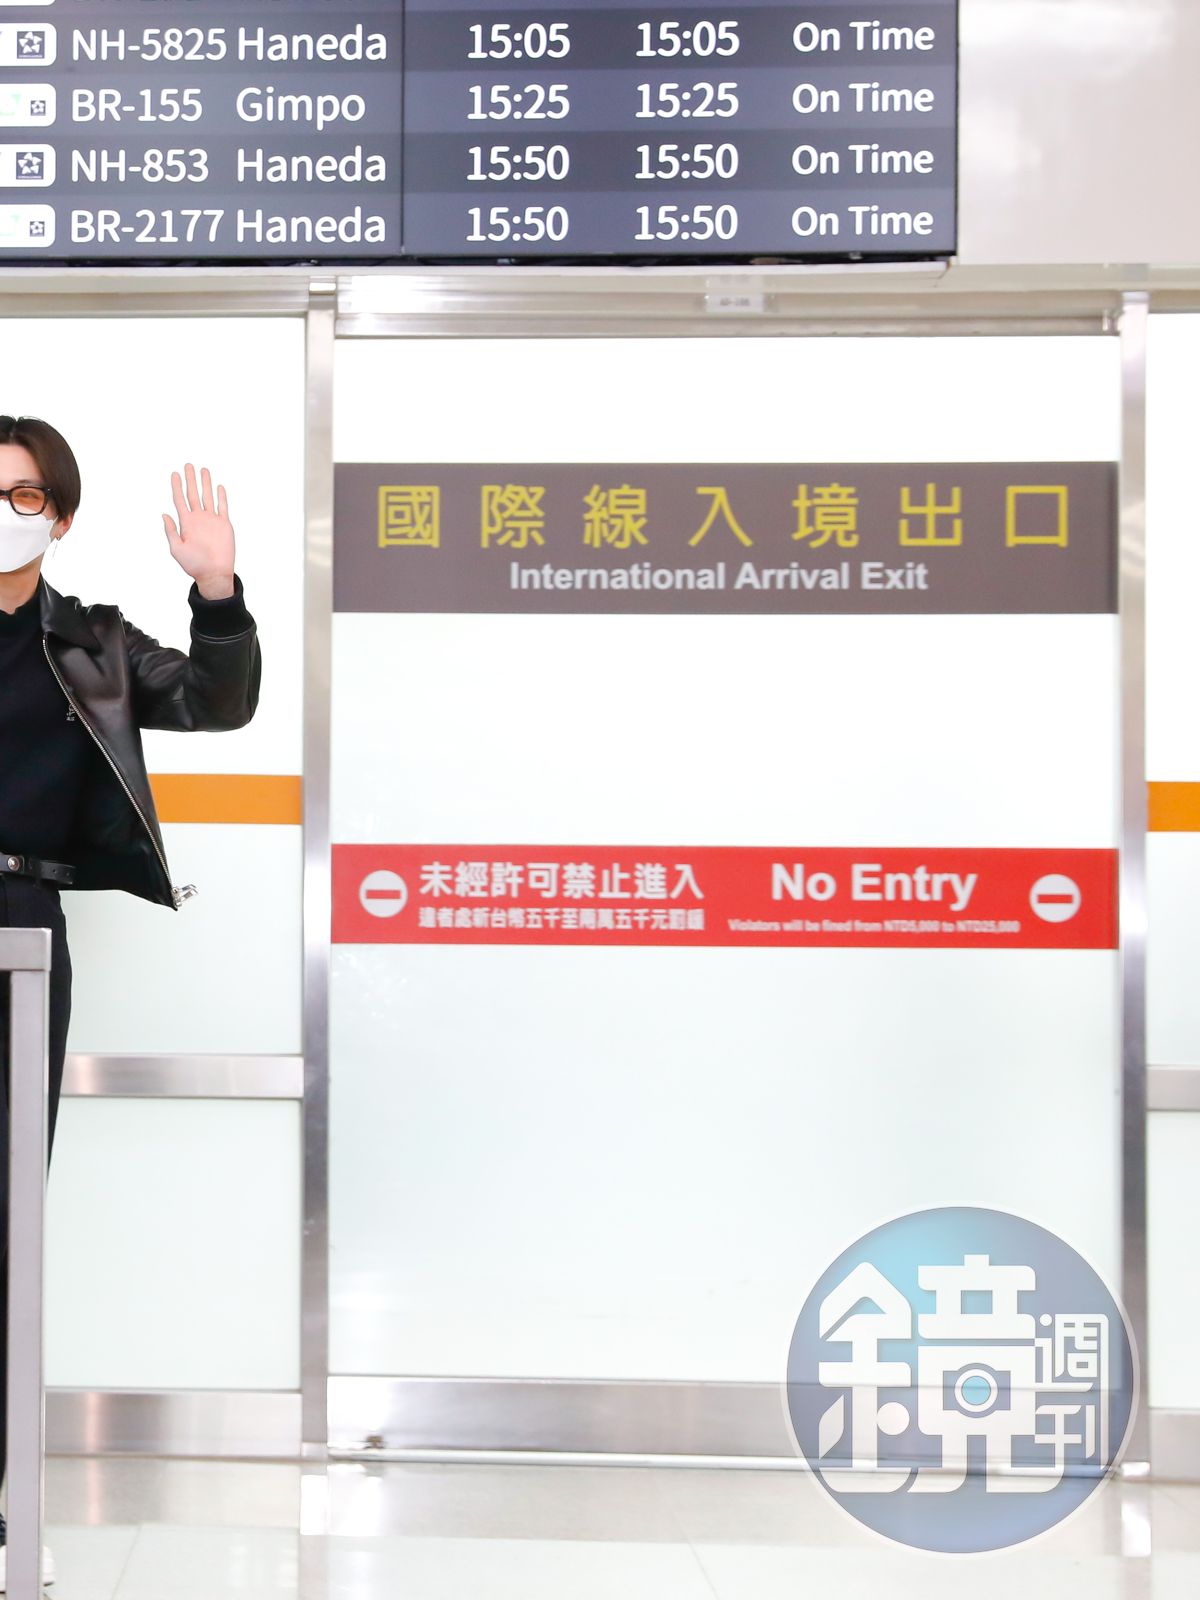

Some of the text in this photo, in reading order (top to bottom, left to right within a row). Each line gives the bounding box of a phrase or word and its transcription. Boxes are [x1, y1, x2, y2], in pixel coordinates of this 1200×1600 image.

[72, 27, 227, 61] NH-5825
[238, 23, 387, 62] Haneda
[467, 22, 571, 59] 15:05
[635, 20, 740, 57] 15:05
[792, 21, 841, 52] On
[848, 20, 935, 51] Time
[72, 88, 203, 122] BR-155
[236, 86, 366, 131] Gimpo
[467, 84, 570, 120] 15:25
[635, 82, 739, 118] 15:25
[792, 83, 840, 114] On
[848, 81, 935, 113] Time
[71, 148, 209, 183] NH-853
[237, 145, 386, 183] Haneda
[466, 144, 570, 181] 15:50
[634, 143, 739, 180] 15:50
[791, 144, 840, 175] On
[847, 143, 935, 174] Time
[71, 209, 225, 243] BR-2177
[236, 205, 386, 243] Haneda
[466, 205, 569, 242] 15:50
[634, 204, 738, 241] 15:50
[791, 206, 839, 237] On
[847, 204, 934, 235] Time
[377, 482, 1070, 549] 國際線入境出口
[510, 561, 928, 590] International Arrival Exit
[419, 861, 704, 900] 未經許可禁止進入
[772, 863, 977, 912] No Entry
[727, 918, 781, 933] Violators
[782, 918, 803, 933] will
[805, 918, 820, 933] be
[822, 918, 852, 933] fined
[854, 918, 881, 933] from
[943, 918, 954, 933] to
